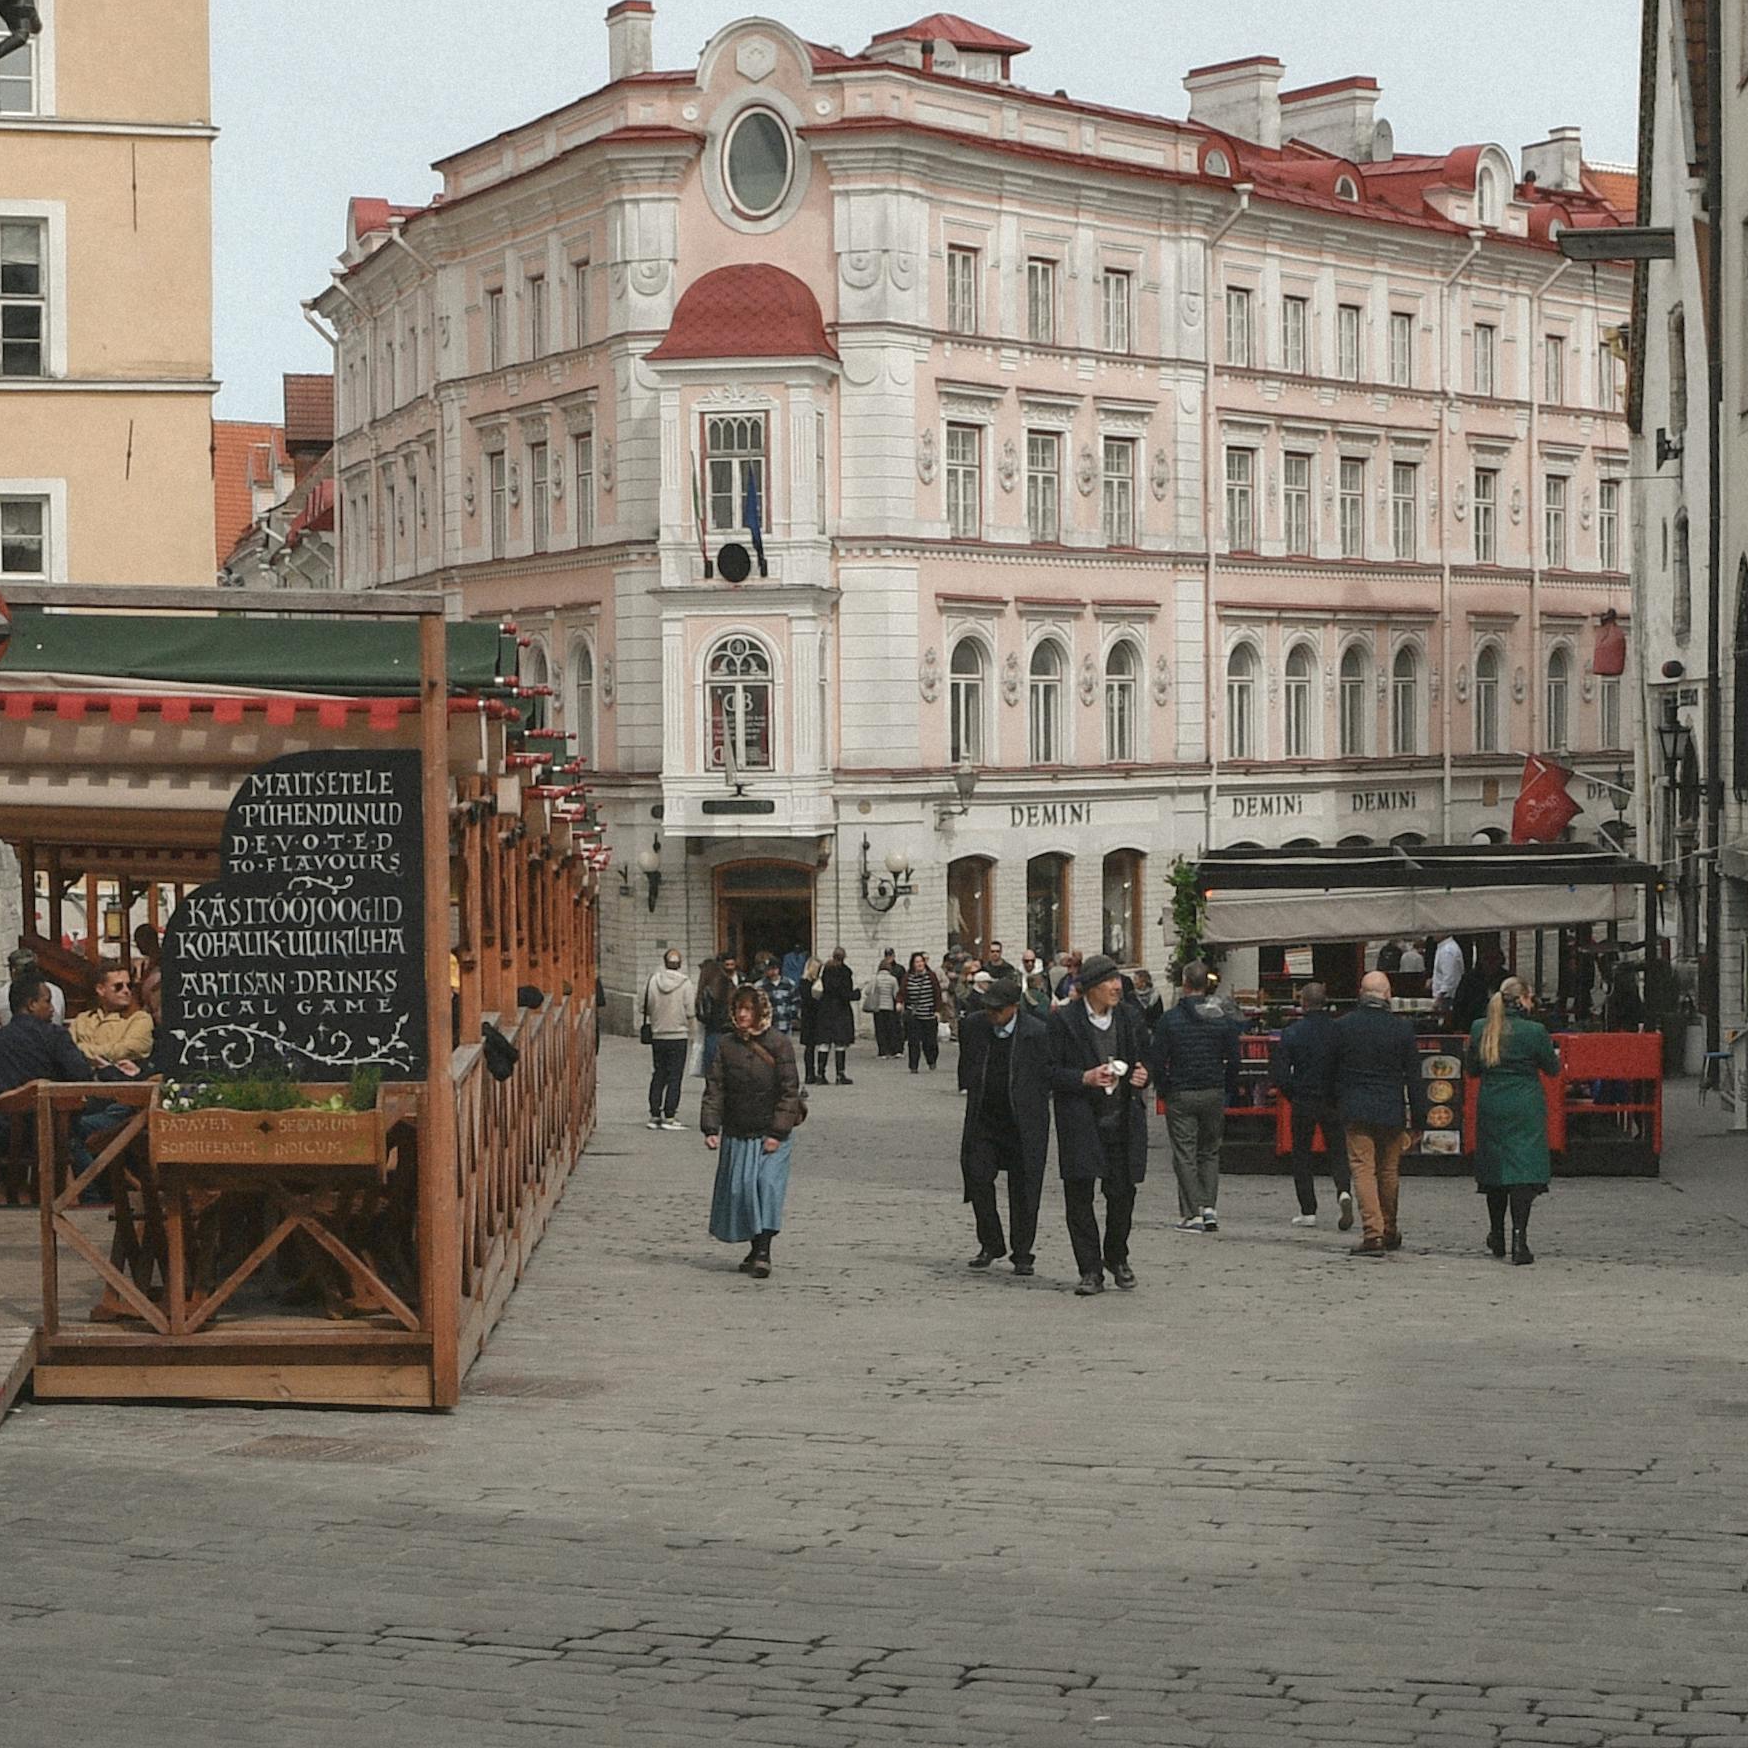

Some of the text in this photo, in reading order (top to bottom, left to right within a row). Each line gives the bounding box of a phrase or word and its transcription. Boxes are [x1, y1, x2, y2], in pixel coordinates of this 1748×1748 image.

[250, 769, 395, 798] MAITSETELE
[183, 996, 394, 1019] LOCAL GAME
